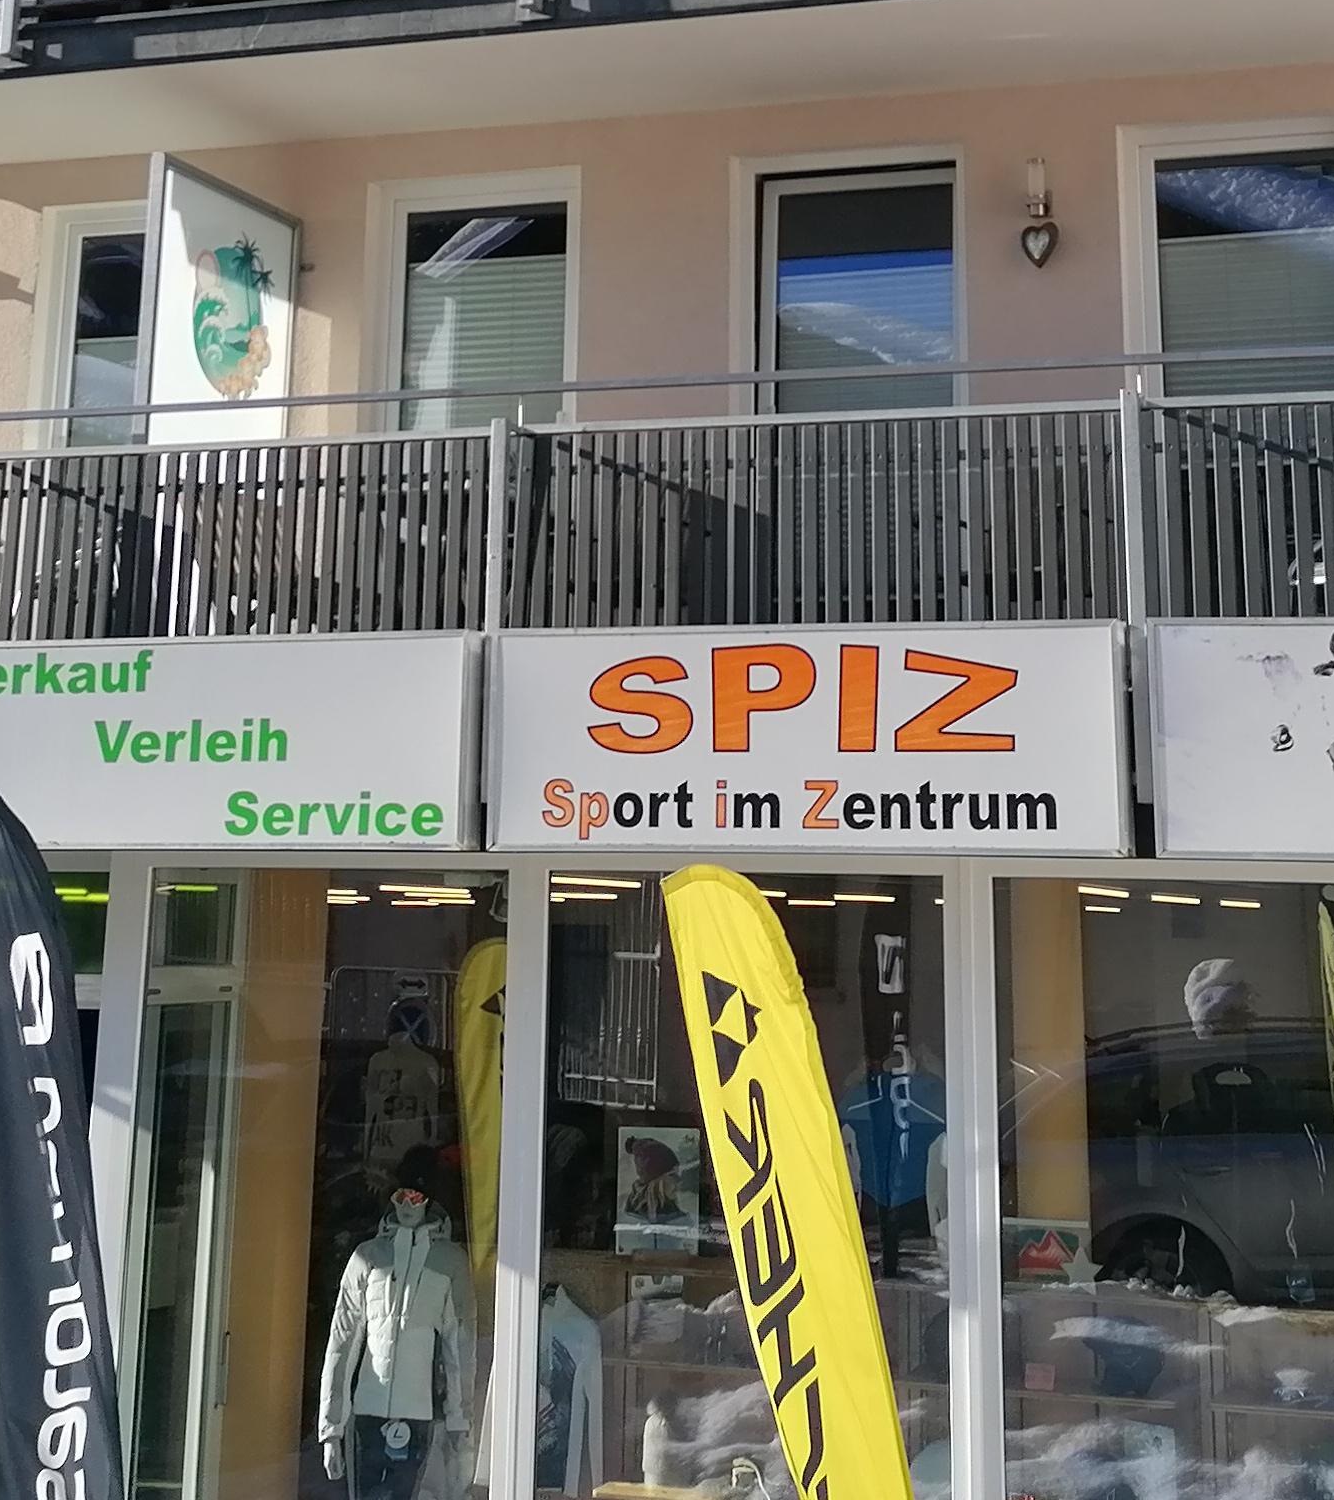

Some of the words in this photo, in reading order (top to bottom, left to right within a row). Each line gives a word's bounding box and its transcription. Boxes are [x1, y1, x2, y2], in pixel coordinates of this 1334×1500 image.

[585, 642, 1019, 755] SPIZ
[94, 717, 290, 765] Verleih
[223, 789, 445, 838] Service
[540, 777, 694, 841] Sport
[714, 779, 782, 831] im
[801, 779, 1059, 832] Zentrum
